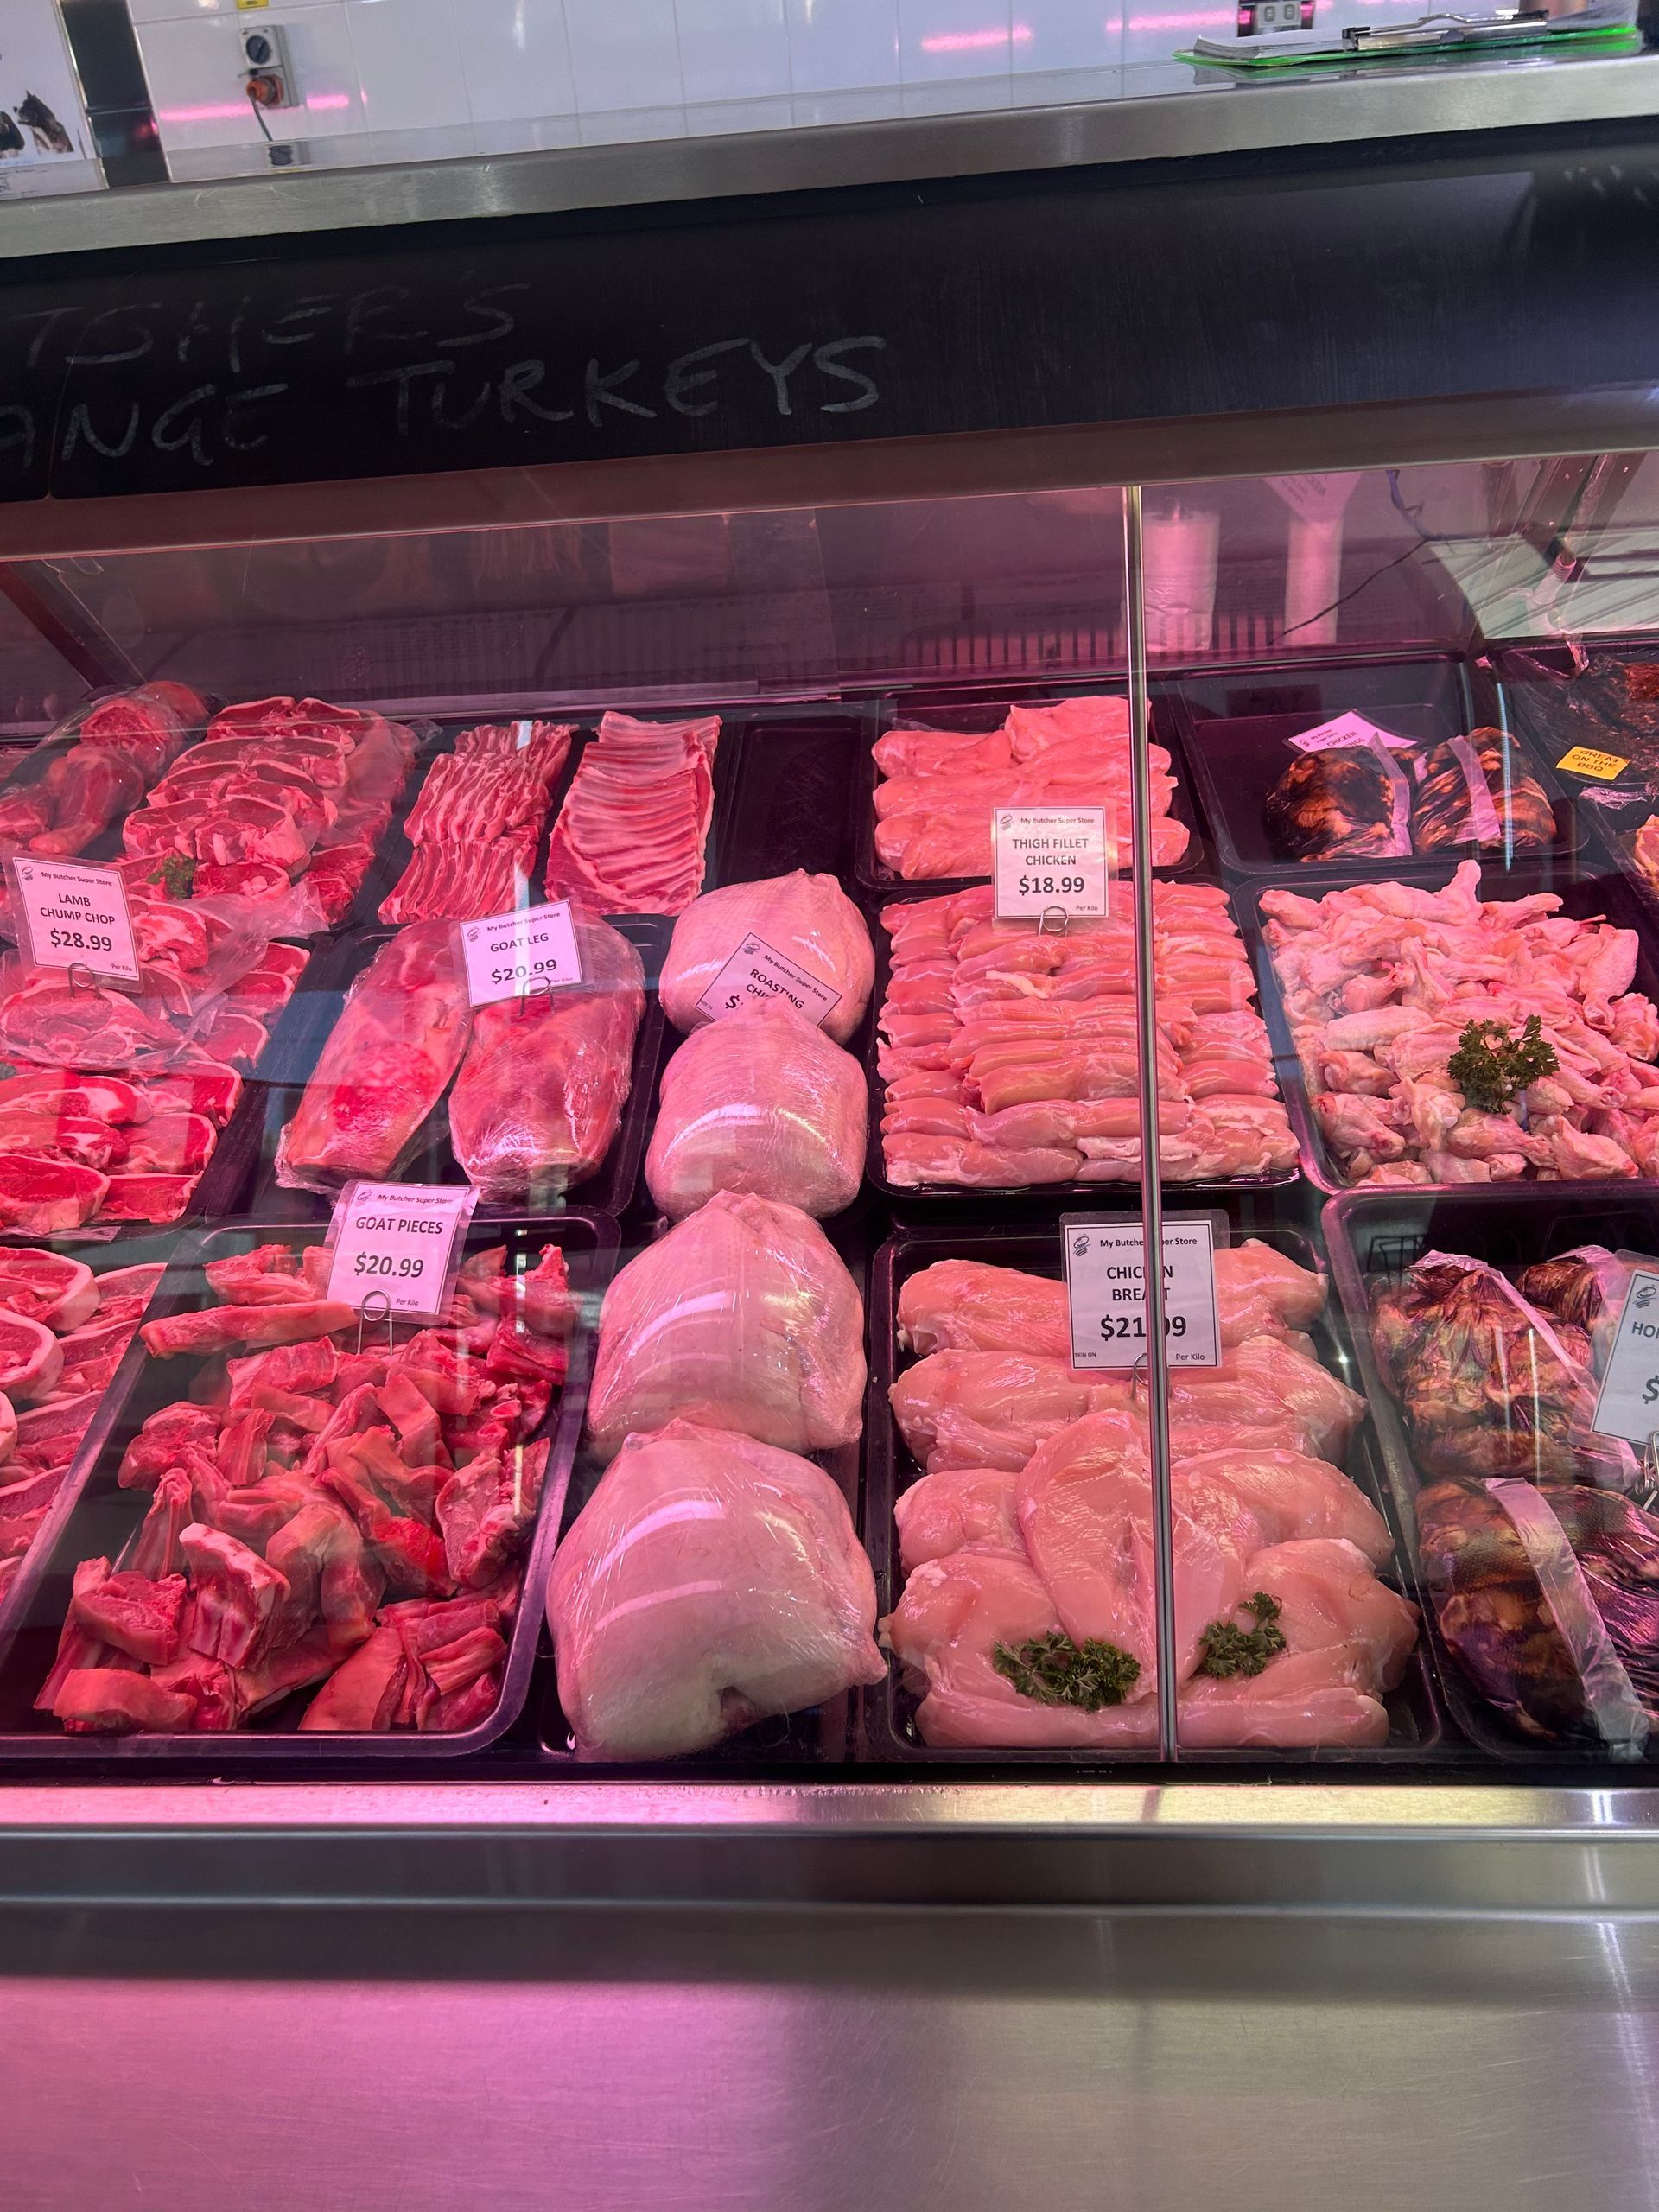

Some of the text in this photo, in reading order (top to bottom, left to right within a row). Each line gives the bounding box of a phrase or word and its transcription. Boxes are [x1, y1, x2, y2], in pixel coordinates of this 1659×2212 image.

[346, 335, 887, 435] TURKEYS
[1580, 750, 1620, 763] GREAT
[1592, 759, 1618, 768] THE
[1577, 762, 1604, 772] BBQ
[1012, 838, 1089, 849] THIGH FILLET
[1025, 855, 1077, 866] CHICKEN
[53, 873, 76, 881] Butcher
[1019, 875, 1084, 896] $18.99
[58, 893, 91, 906] LAMB
[40, 907, 115, 925] CHUMP CHOP
[499, 920, 523, 929] Butcher
[543, 912, 561, 920] Store
[50, 928, 112, 952] $28.99
[490, 933, 550, 952] GOAT LEG
[491, 959, 557, 985] $20.99
[764, 954, 828, 1001] My Butcher Super Store
[356, 1217, 443, 1235] GOAT PIECES
[1100, 1239, 1114, 1249] My
[1116, 1238, 1145, 1248] Butche
[354, 1252, 424, 1279] $20.99
[407, 1298, 419, 1306] Kilo
[1190, 1352, 1205, 1361] Kilo
